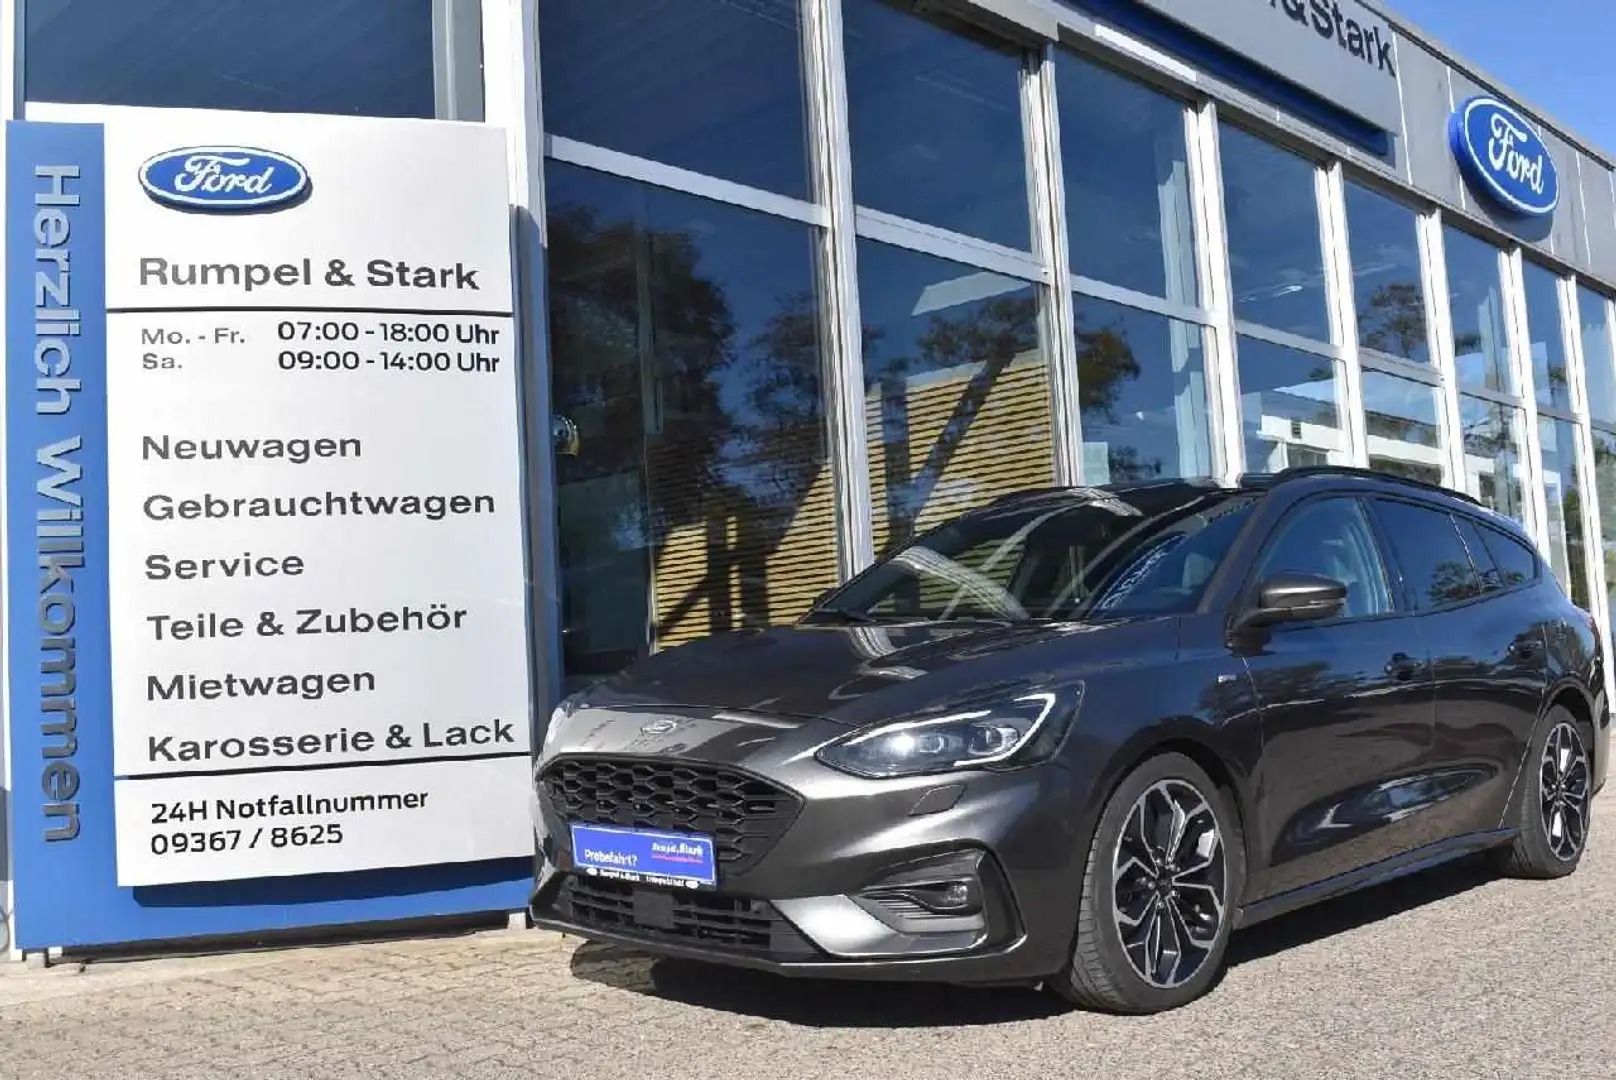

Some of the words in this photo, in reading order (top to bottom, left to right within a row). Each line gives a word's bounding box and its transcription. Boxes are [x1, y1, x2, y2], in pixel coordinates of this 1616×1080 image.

[1309, 0, 1397, 78] Stark
[1488, 113, 1545, 194] Ford
[174, 154, 275, 194] Ford
[34, 164, 81, 415] Herzlich
[140, 257, 311, 292] Rumpel
[324, 259, 356, 287] &
[367, 259, 480, 291] Stark
[141, 328, 191, 345] Mo.
[214, 327, 245, 344] Fr.
[277, 320, 360, 341] 07:00
[378, 322, 450, 343] 18:00
[455, 323, 500, 345] Uhr
[142, 352, 182, 370] Sa.
[277, 350, 360, 370] 09:00
[379, 351, 451, 372] 14:00
[456, 352, 500, 373] Uhr
[142, 434, 362, 465] Neuwagen
[143, 490, 496, 521] Gebrauchtwagen
[145, 551, 305, 580] Service
[36, 434, 85, 843] Willkommen
[146, 612, 244, 641] Teile
[256, 611, 285, 637] &
[295, 603, 468, 635] Zubehör
[147, 671, 375, 702] Mietwagen
[148, 727, 376, 763] Karosserie
[385, 723, 413, 750] &
[422, 718, 515, 748] Lack
[150, 800, 208, 825] 24H
[215, 791, 429, 820] Notfallnummer
[150, 831, 242, 856] 09367
[248, 827, 264, 850] /
[270, 823, 344, 848] 8625
